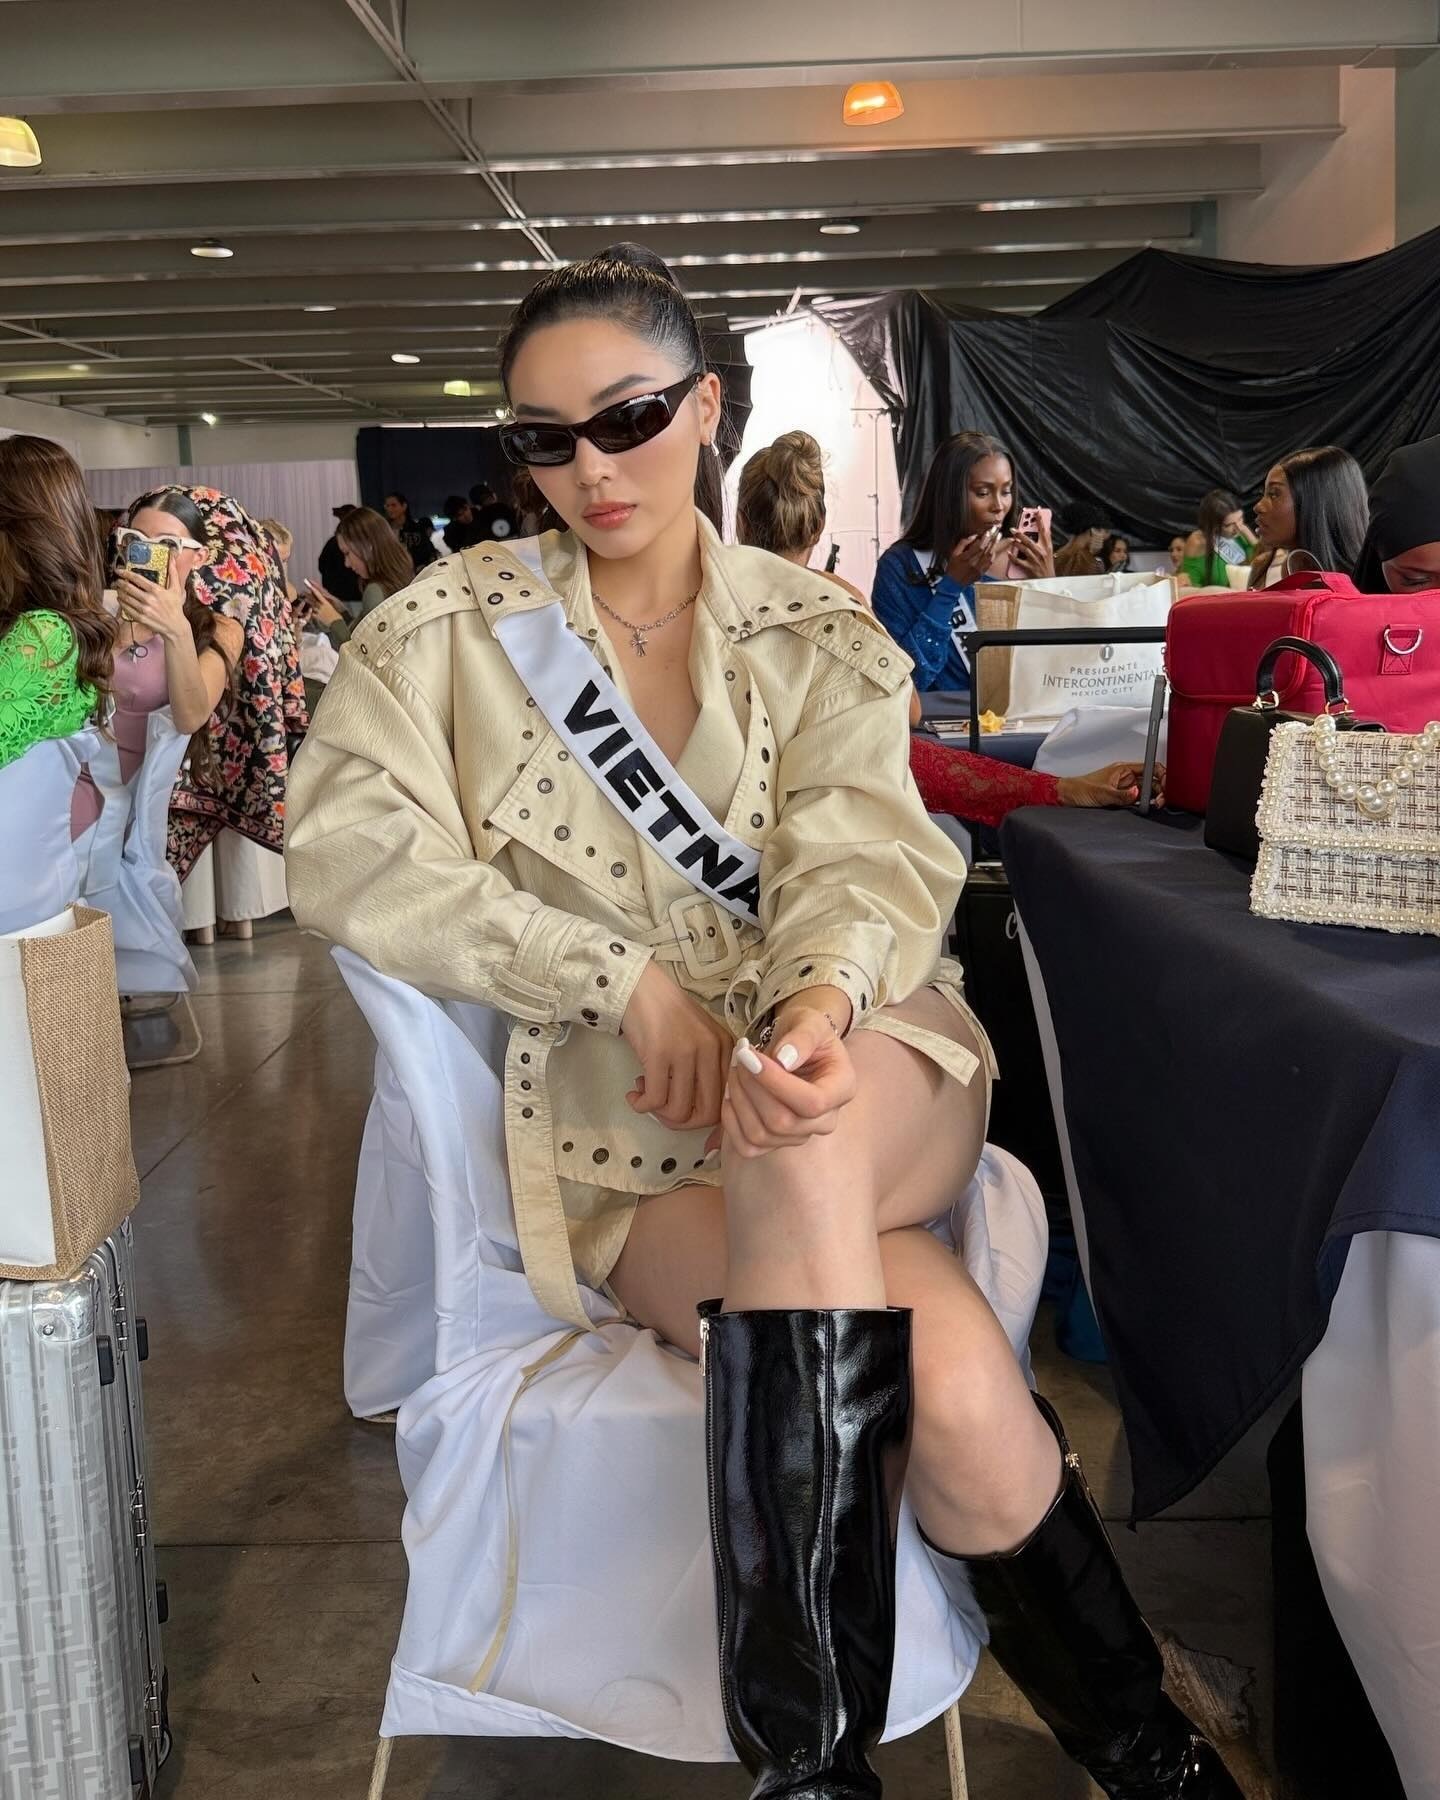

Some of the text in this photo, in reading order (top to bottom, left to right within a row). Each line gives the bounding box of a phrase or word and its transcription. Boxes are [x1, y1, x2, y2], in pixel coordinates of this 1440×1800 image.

[1069, 662, 1138, 676] PRESIDENTE
[1071, 686, 1134, 697] MEXICO CITY
